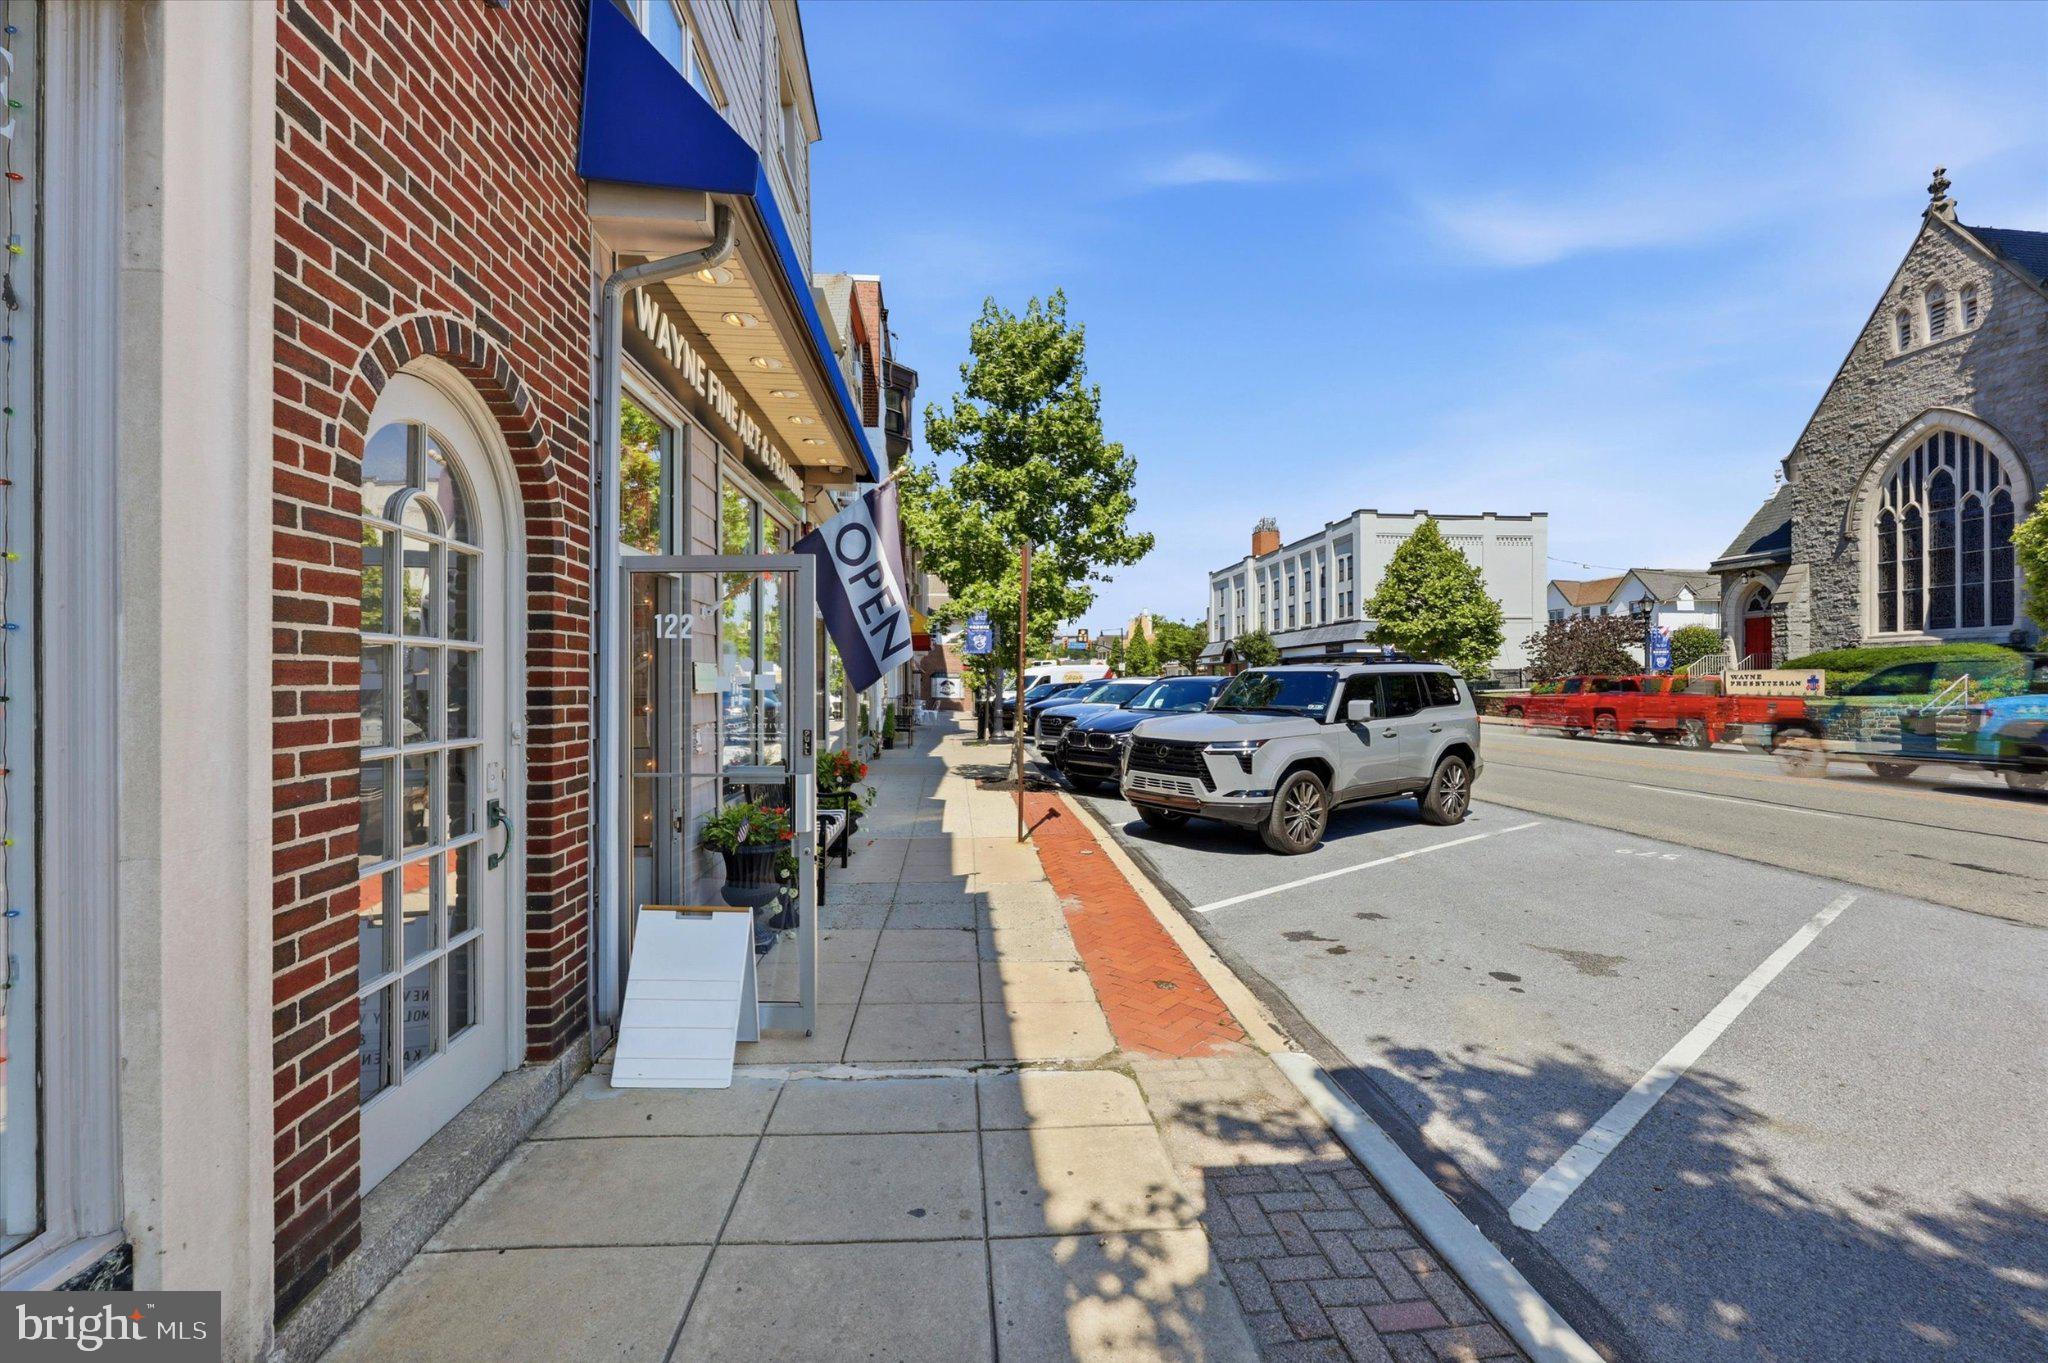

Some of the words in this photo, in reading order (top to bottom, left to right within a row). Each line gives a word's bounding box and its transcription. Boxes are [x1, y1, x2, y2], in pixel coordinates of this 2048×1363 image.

[635, 285, 707, 397] WAYNE
[707, 369, 739, 432] FINE
[737, 408, 762, 455] ART
[760, 434, 770, 466] &
[654, 613, 694, 639] 122
[835, 522, 911, 662] OPEN
